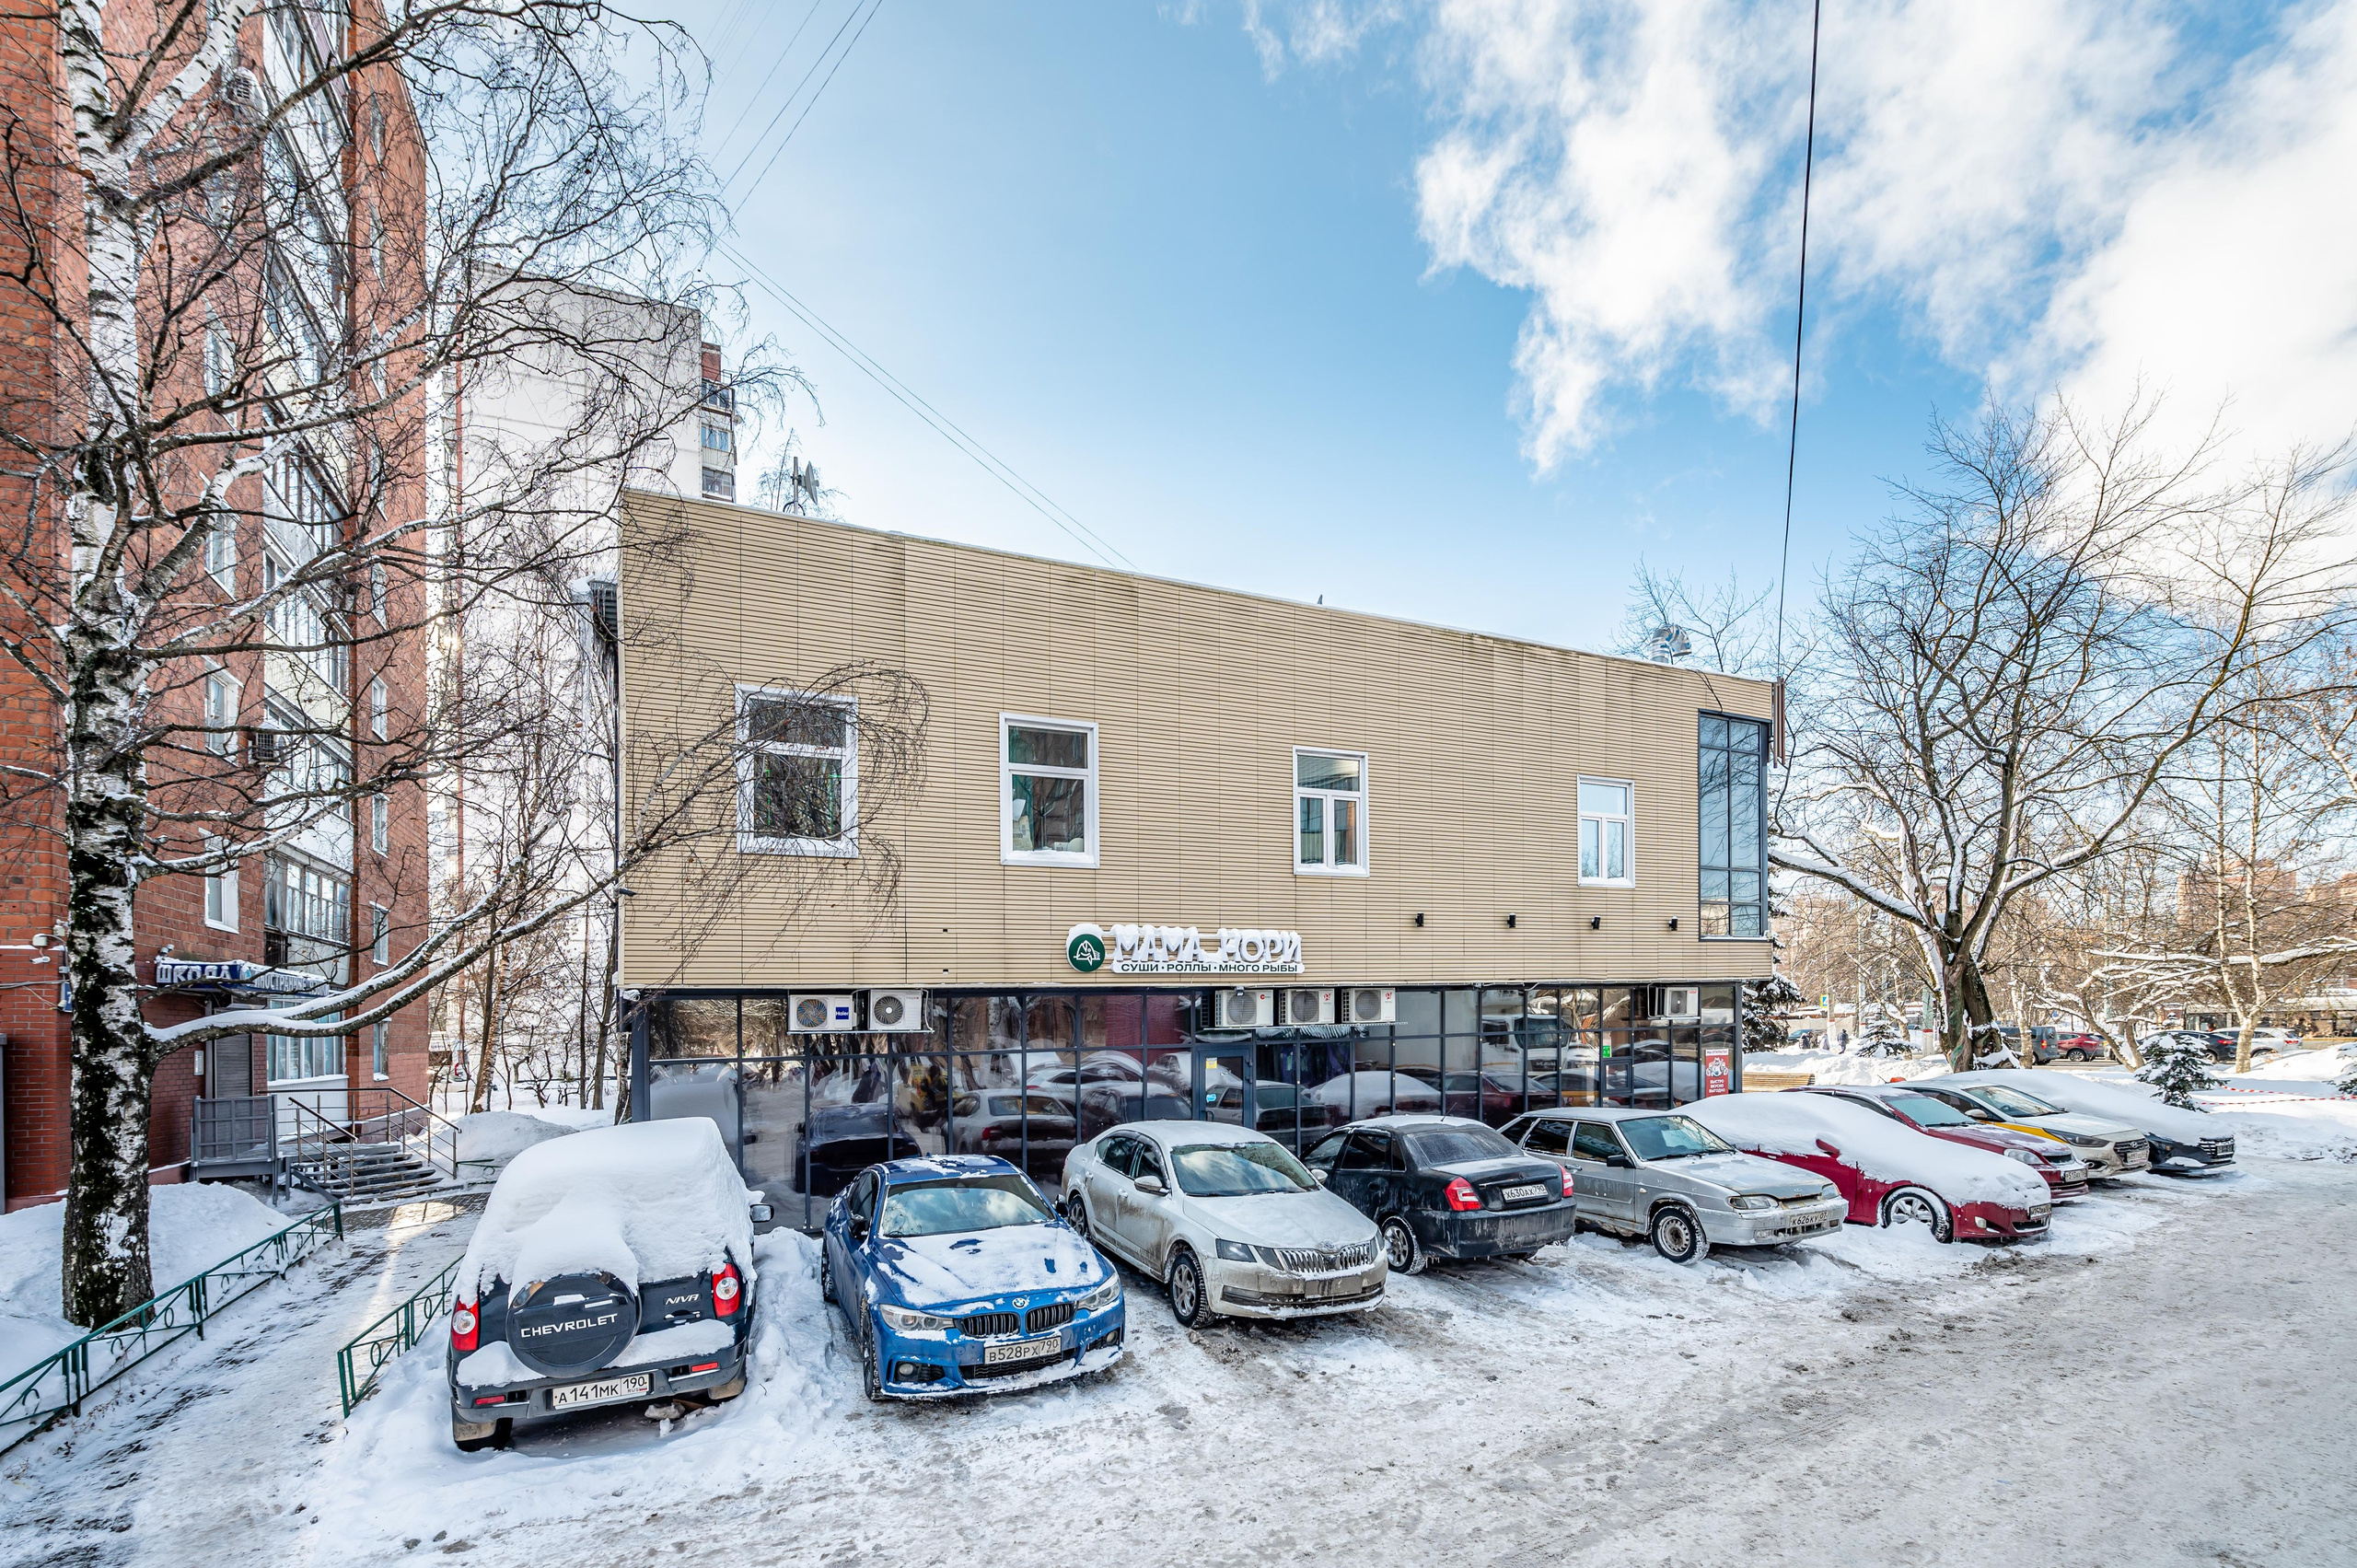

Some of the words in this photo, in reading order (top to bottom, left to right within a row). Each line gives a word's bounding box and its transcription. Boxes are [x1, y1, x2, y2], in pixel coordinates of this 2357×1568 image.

[1116, 927, 1204, 963] МАМА
[1221, 929, 1302, 963] НОРИ
[1120, 963, 1159, 972] СУШИ
[1167, 963, 1212, 972] РОЛЛЫ
[1219, 964, 1260, 972] МНОГО
[1262, 964, 1298, 972] РЫБЫ
[665, 1294, 700, 1306] NIVA
[520, 1313, 618, 1338] CHEVROLET
[1040, 1339, 1059, 1351] 790
[622, 1376, 645, 1389] 190
